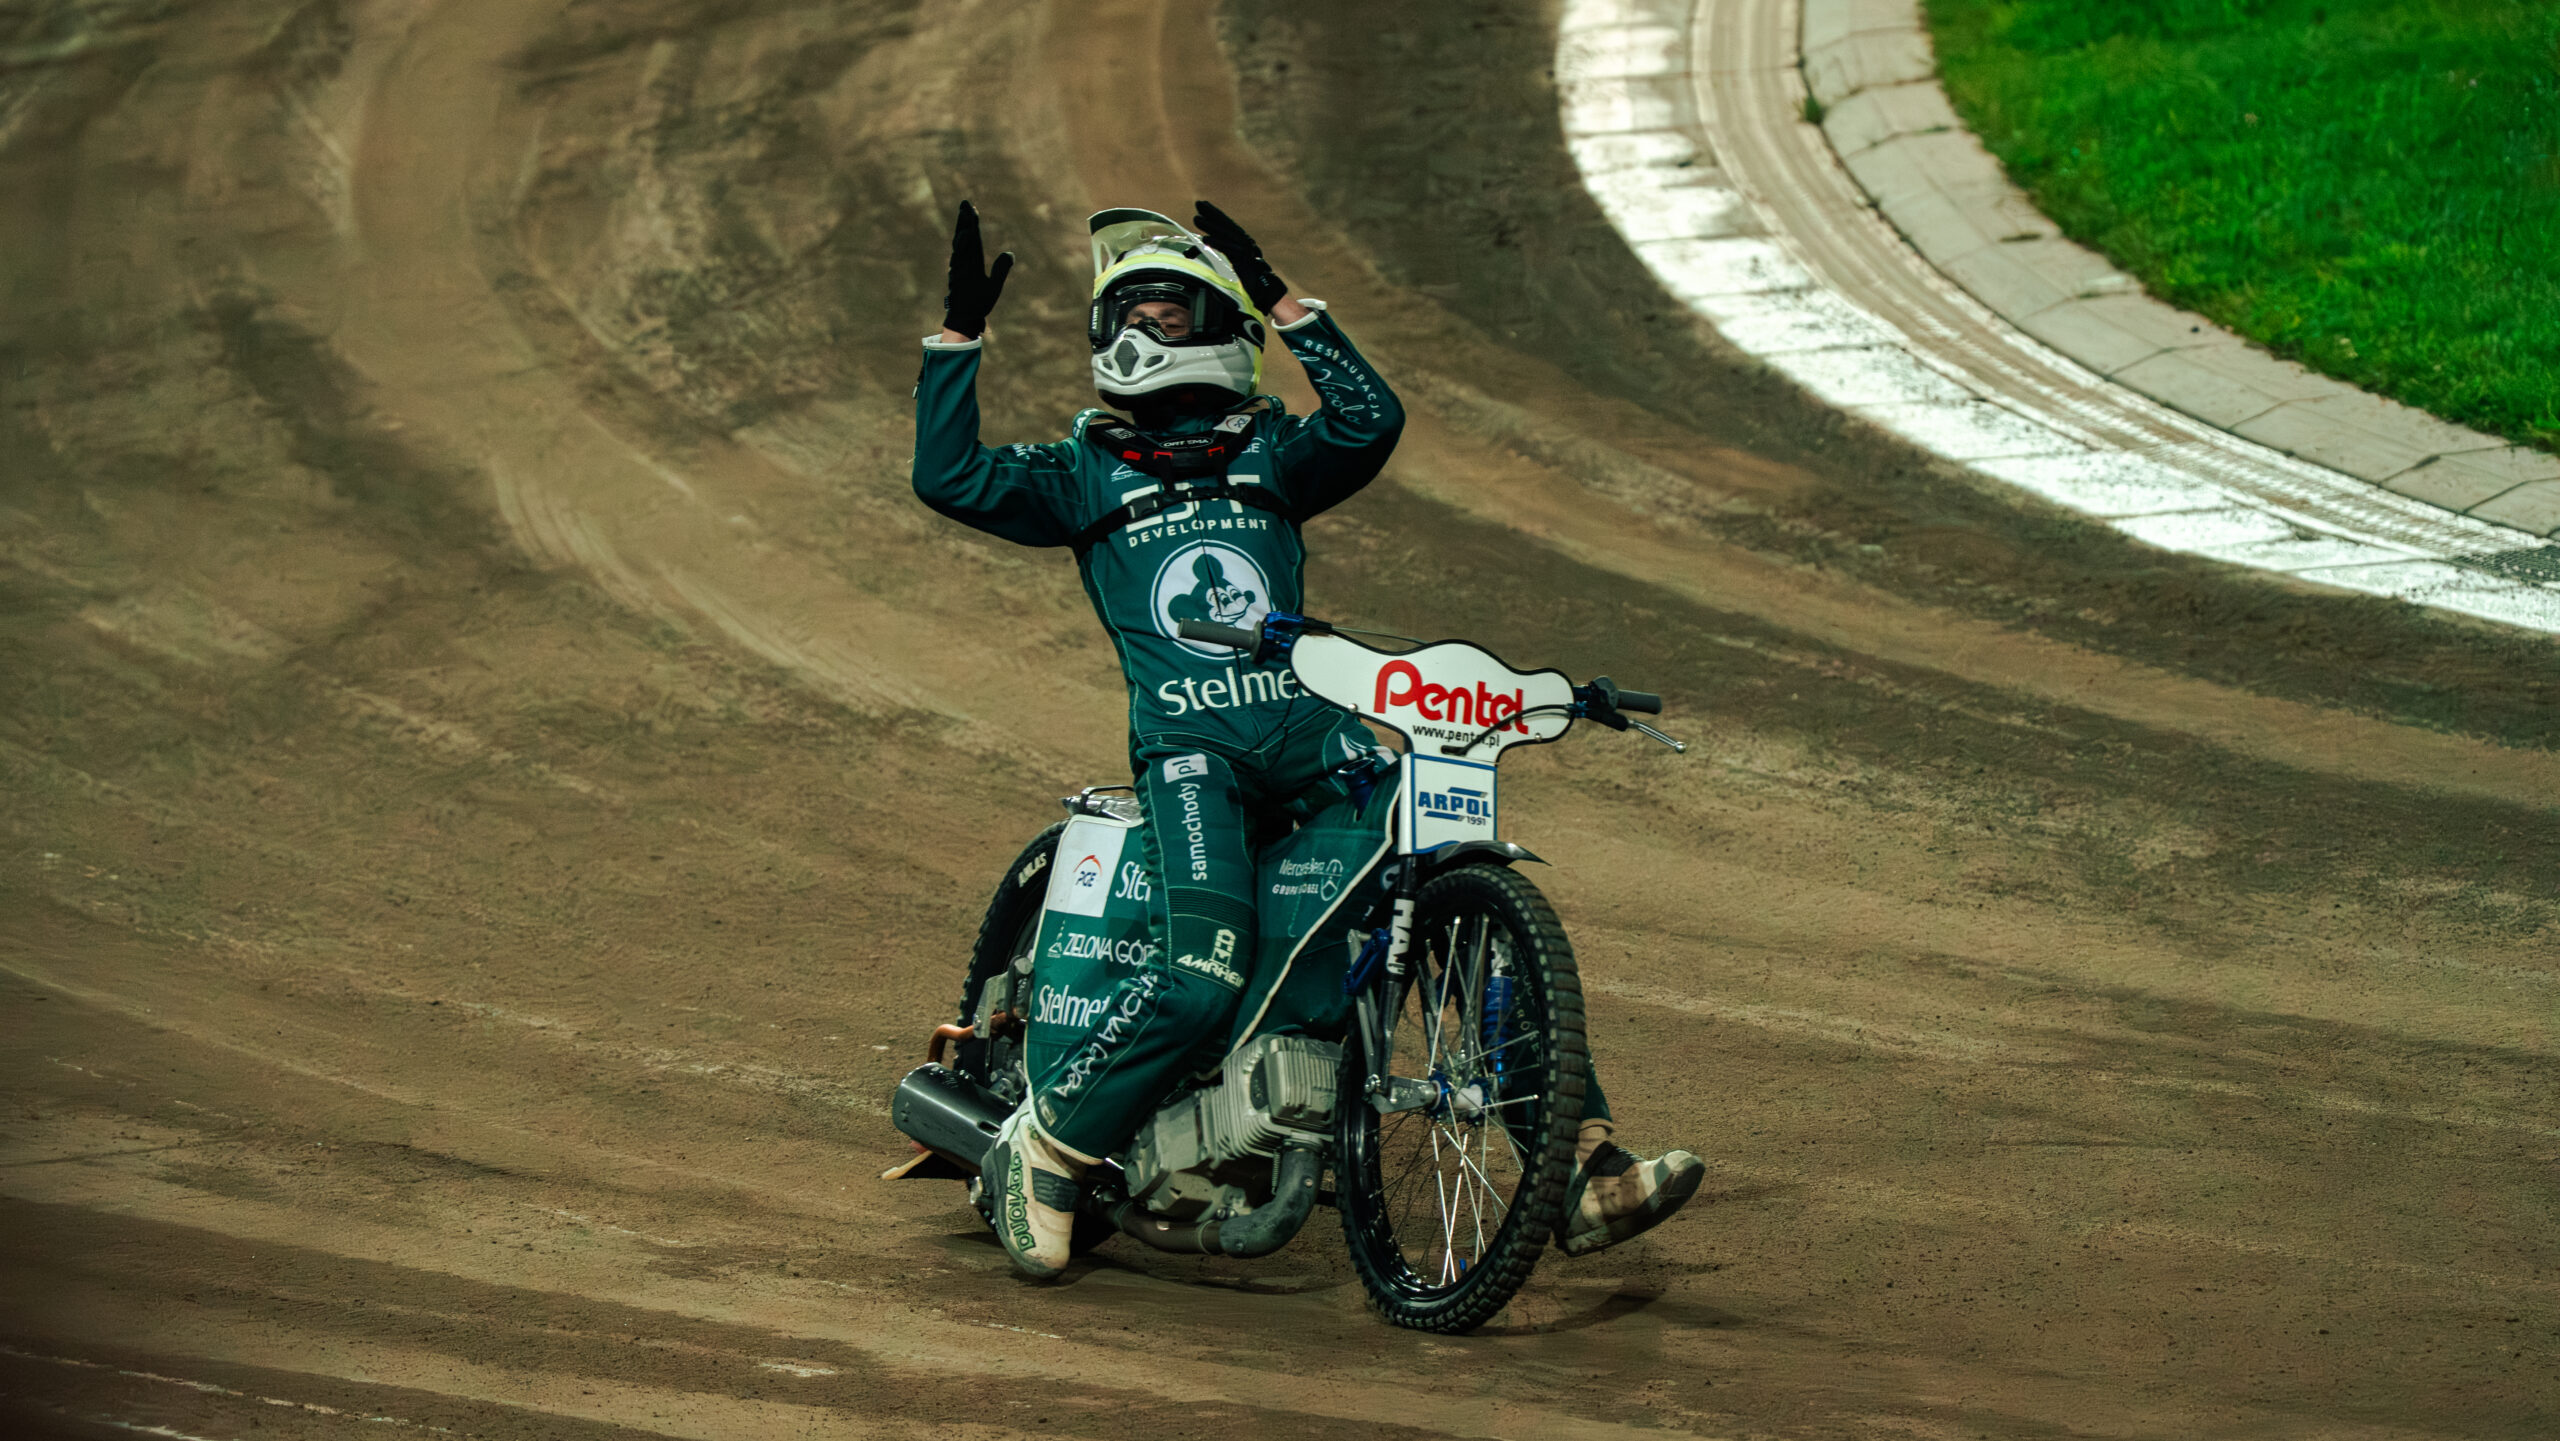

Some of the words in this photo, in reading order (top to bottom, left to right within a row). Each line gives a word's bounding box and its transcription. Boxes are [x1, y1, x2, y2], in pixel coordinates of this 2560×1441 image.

[1129, 517, 1268, 548] DEVELOPMENT
[1157, 666, 1311, 716] Stelme
[1373, 659, 1529, 735] Pentel
[1418, 791, 1491, 818] ARPOL
[1466, 815, 1487, 826] 1991
[1178, 782, 1208, 881] samochody
